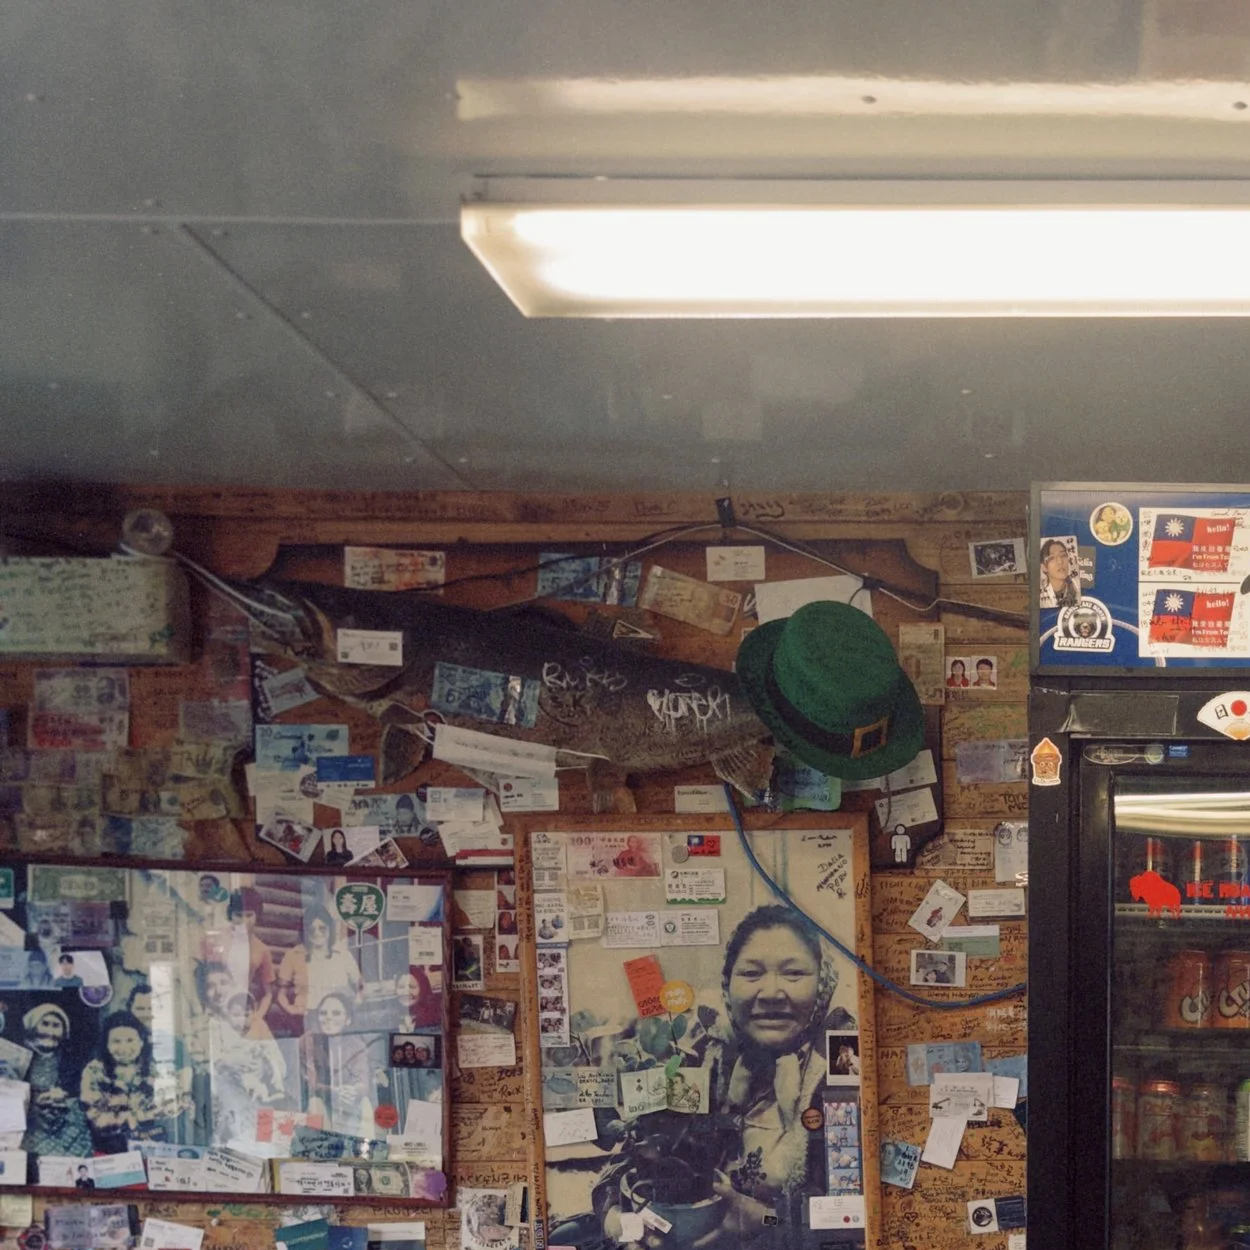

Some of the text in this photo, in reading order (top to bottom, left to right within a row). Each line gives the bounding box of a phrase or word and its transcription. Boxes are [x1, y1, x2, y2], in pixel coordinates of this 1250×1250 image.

[1206, 523, 1230, 533] hello!
[1206, 599, 1230, 609] hello!
[1058, 638, 1110, 650] RANGERS
